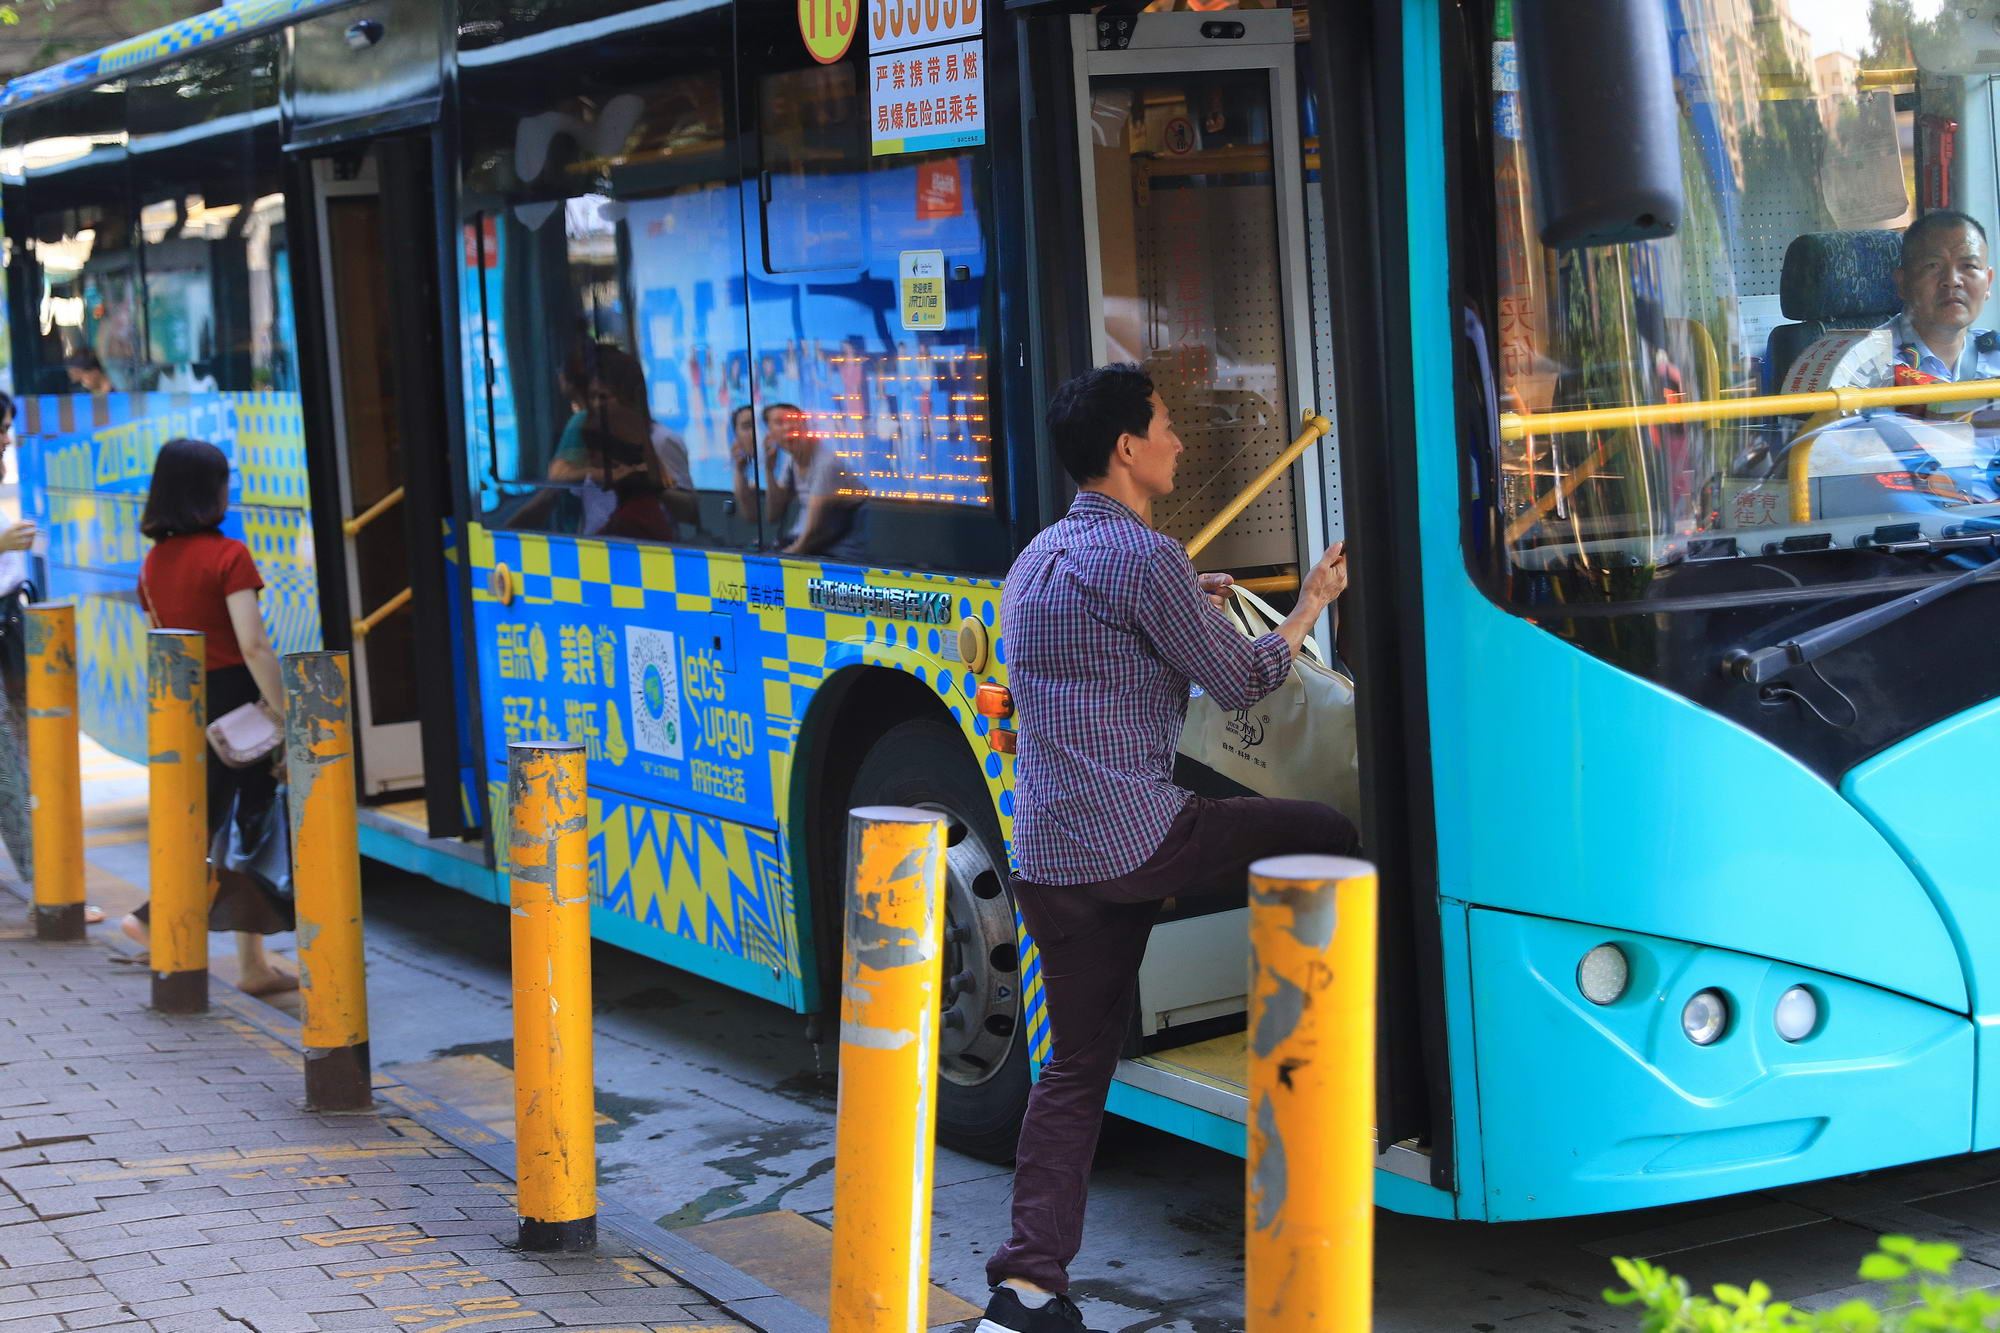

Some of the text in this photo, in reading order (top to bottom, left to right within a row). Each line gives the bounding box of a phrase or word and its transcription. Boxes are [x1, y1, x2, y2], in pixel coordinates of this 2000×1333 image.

[876, 50, 978, 92] 严禁携带易燃
[878, 93, 978, 132] 易爆危险品乘车
[716, 580, 785, 612] 公交广告发布
[496, 621, 597, 685] 音乐 美食
[703, 706, 755, 760] upgo
[690, 758, 747, 804] 好好去生活
